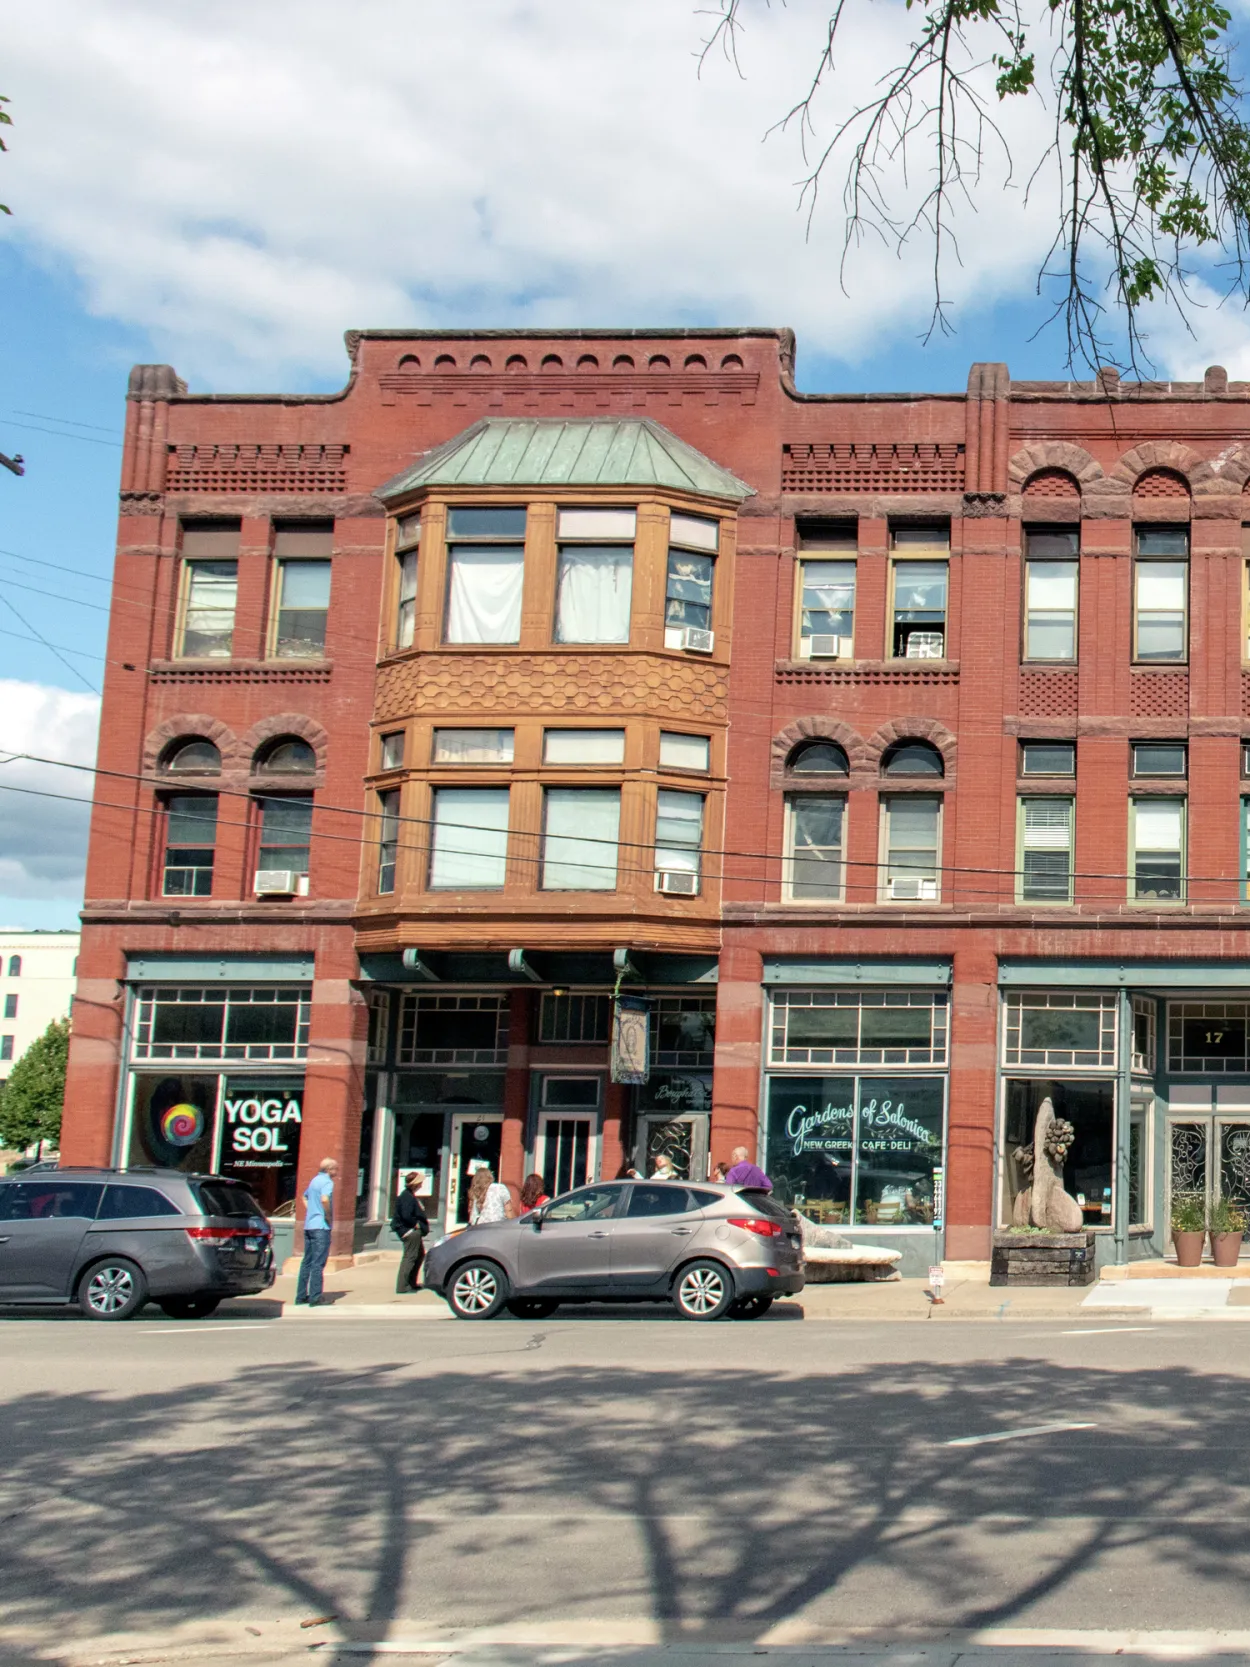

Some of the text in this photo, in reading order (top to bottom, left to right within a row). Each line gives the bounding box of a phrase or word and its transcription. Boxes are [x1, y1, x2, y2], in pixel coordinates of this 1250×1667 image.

[1205, 1031, 1224, 1044] 17
[223, 1099, 302, 1123] YOGA
[786, 1098, 930, 1157] Gardens of Salonica
[232, 1127, 288, 1151] SOL
[803, 1140, 825, 1150] NEW
[825, 1140, 853, 1150] GREEK
[233, 1160, 284, 1169] NE Minneapolis
